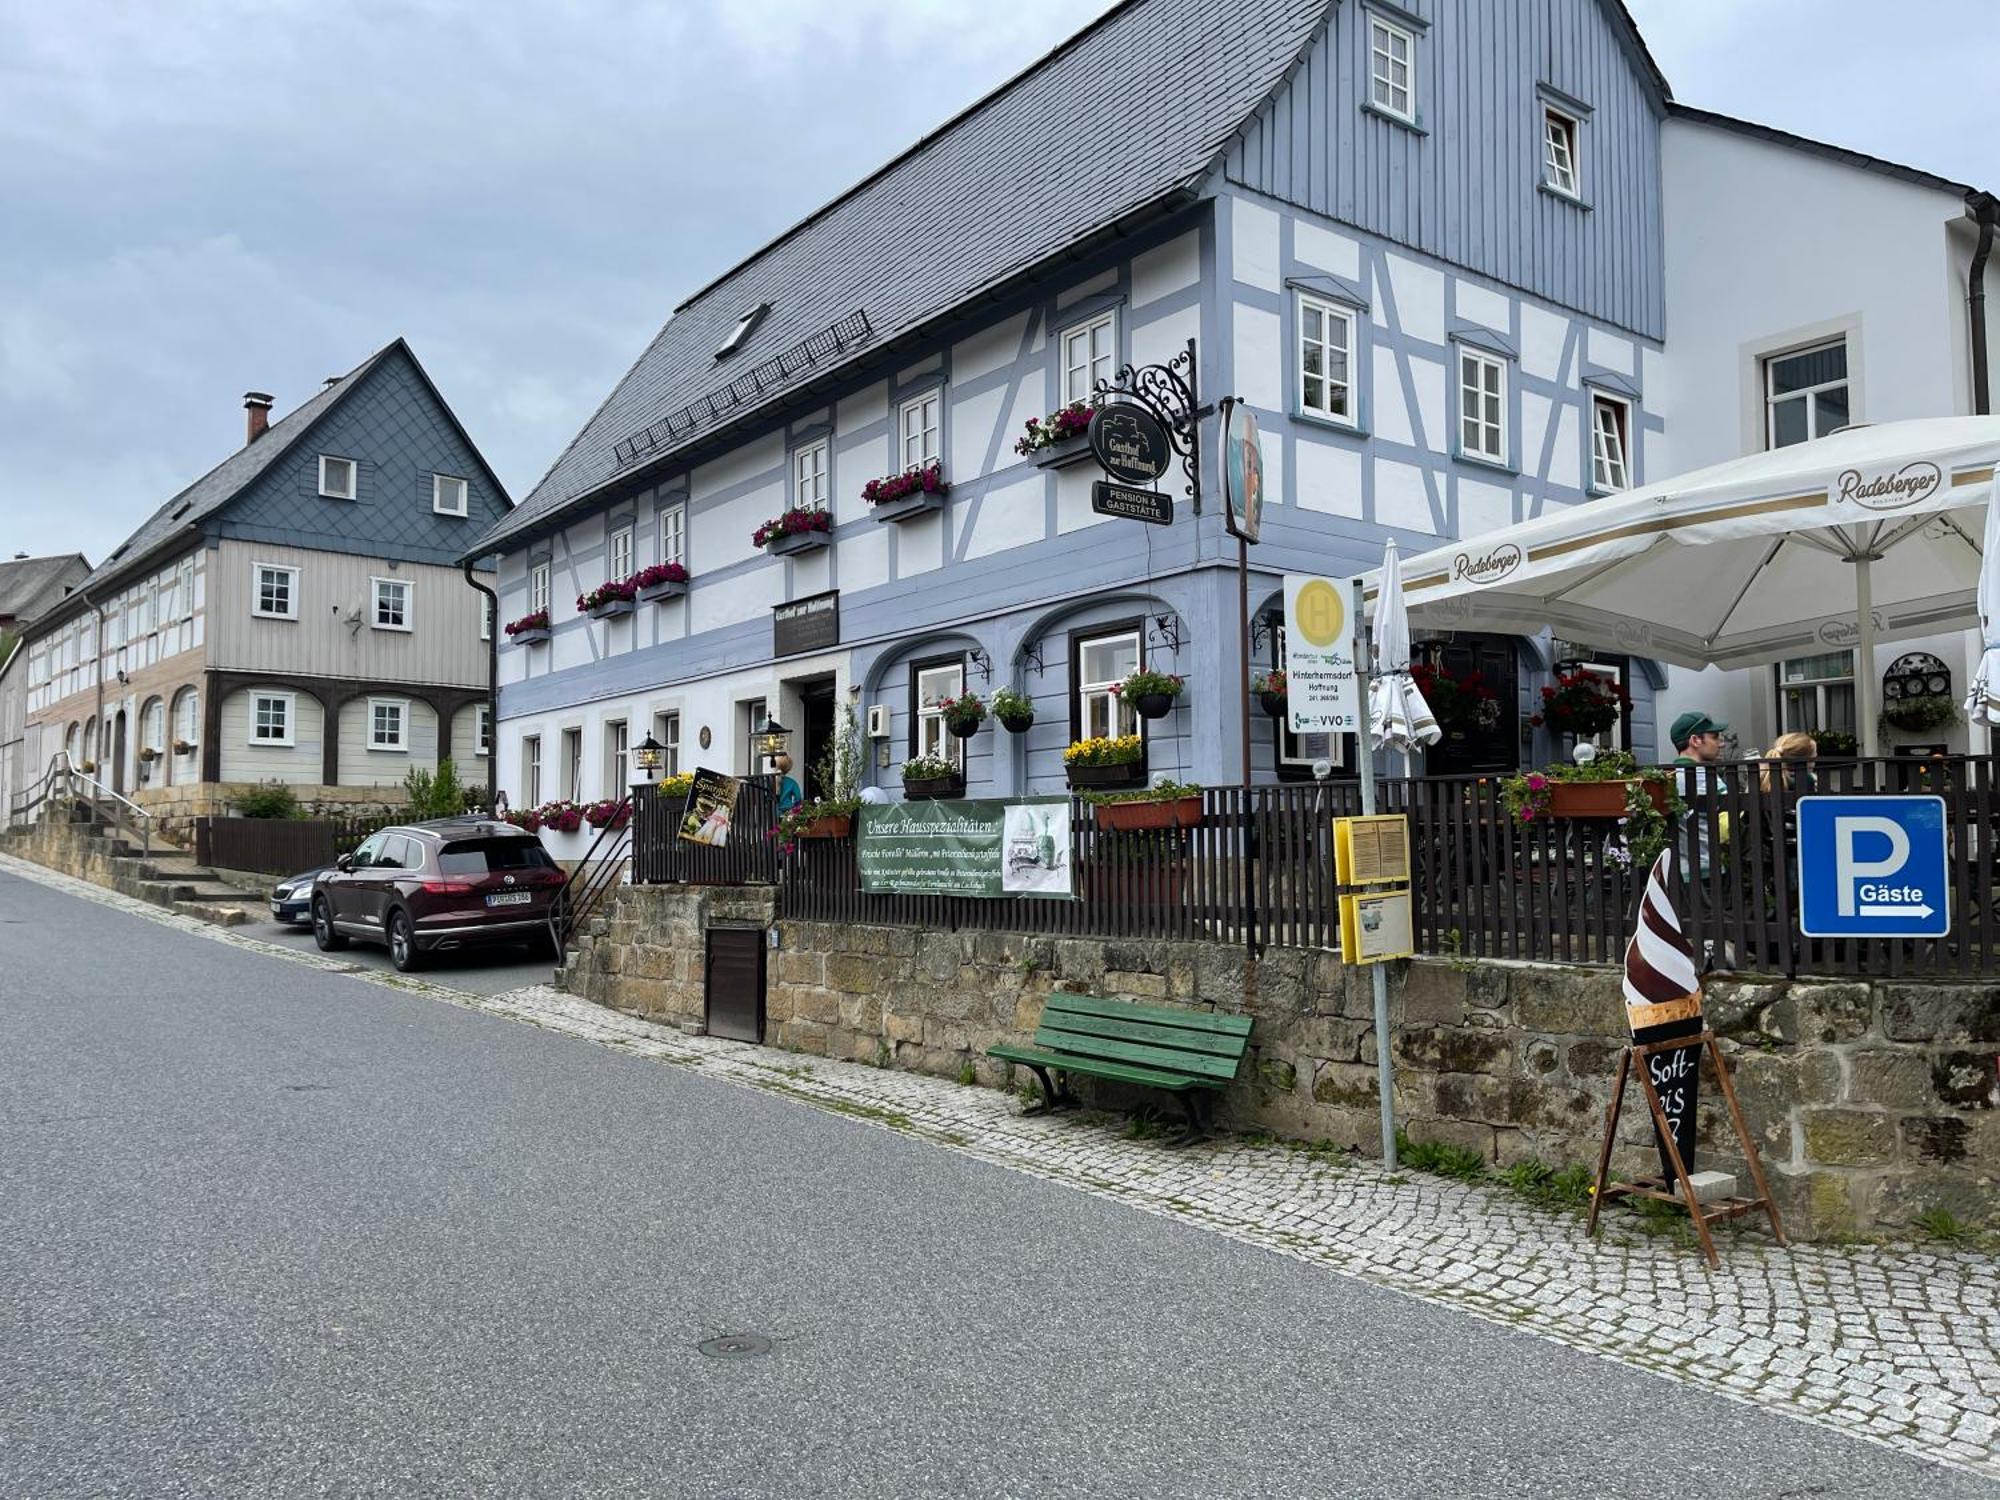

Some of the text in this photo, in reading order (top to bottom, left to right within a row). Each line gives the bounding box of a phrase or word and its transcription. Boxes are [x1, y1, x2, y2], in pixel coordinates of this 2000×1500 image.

[1109, 438, 1140, 456] Gasthof
[1837, 465, 1939, 507] Radeberger
[1110, 489, 1157, 506] PENSION &
[1106, 500, 1161, 518] GASTSTÄTTE
[1454, 547, 1520, 583] Radeberger
[1292, 670, 1353, 680] Hinterhermsdorf
[1308, 683, 1338, 692] Hoffnung
[1320, 715, 1344, 726] VVO
[867, 817, 899, 835] Unsere
[1835, 816, 1910, 916] P
[1860, 884, 1923, 902] Gäste
[1650, 1049, 1695, 1086] Soft-
